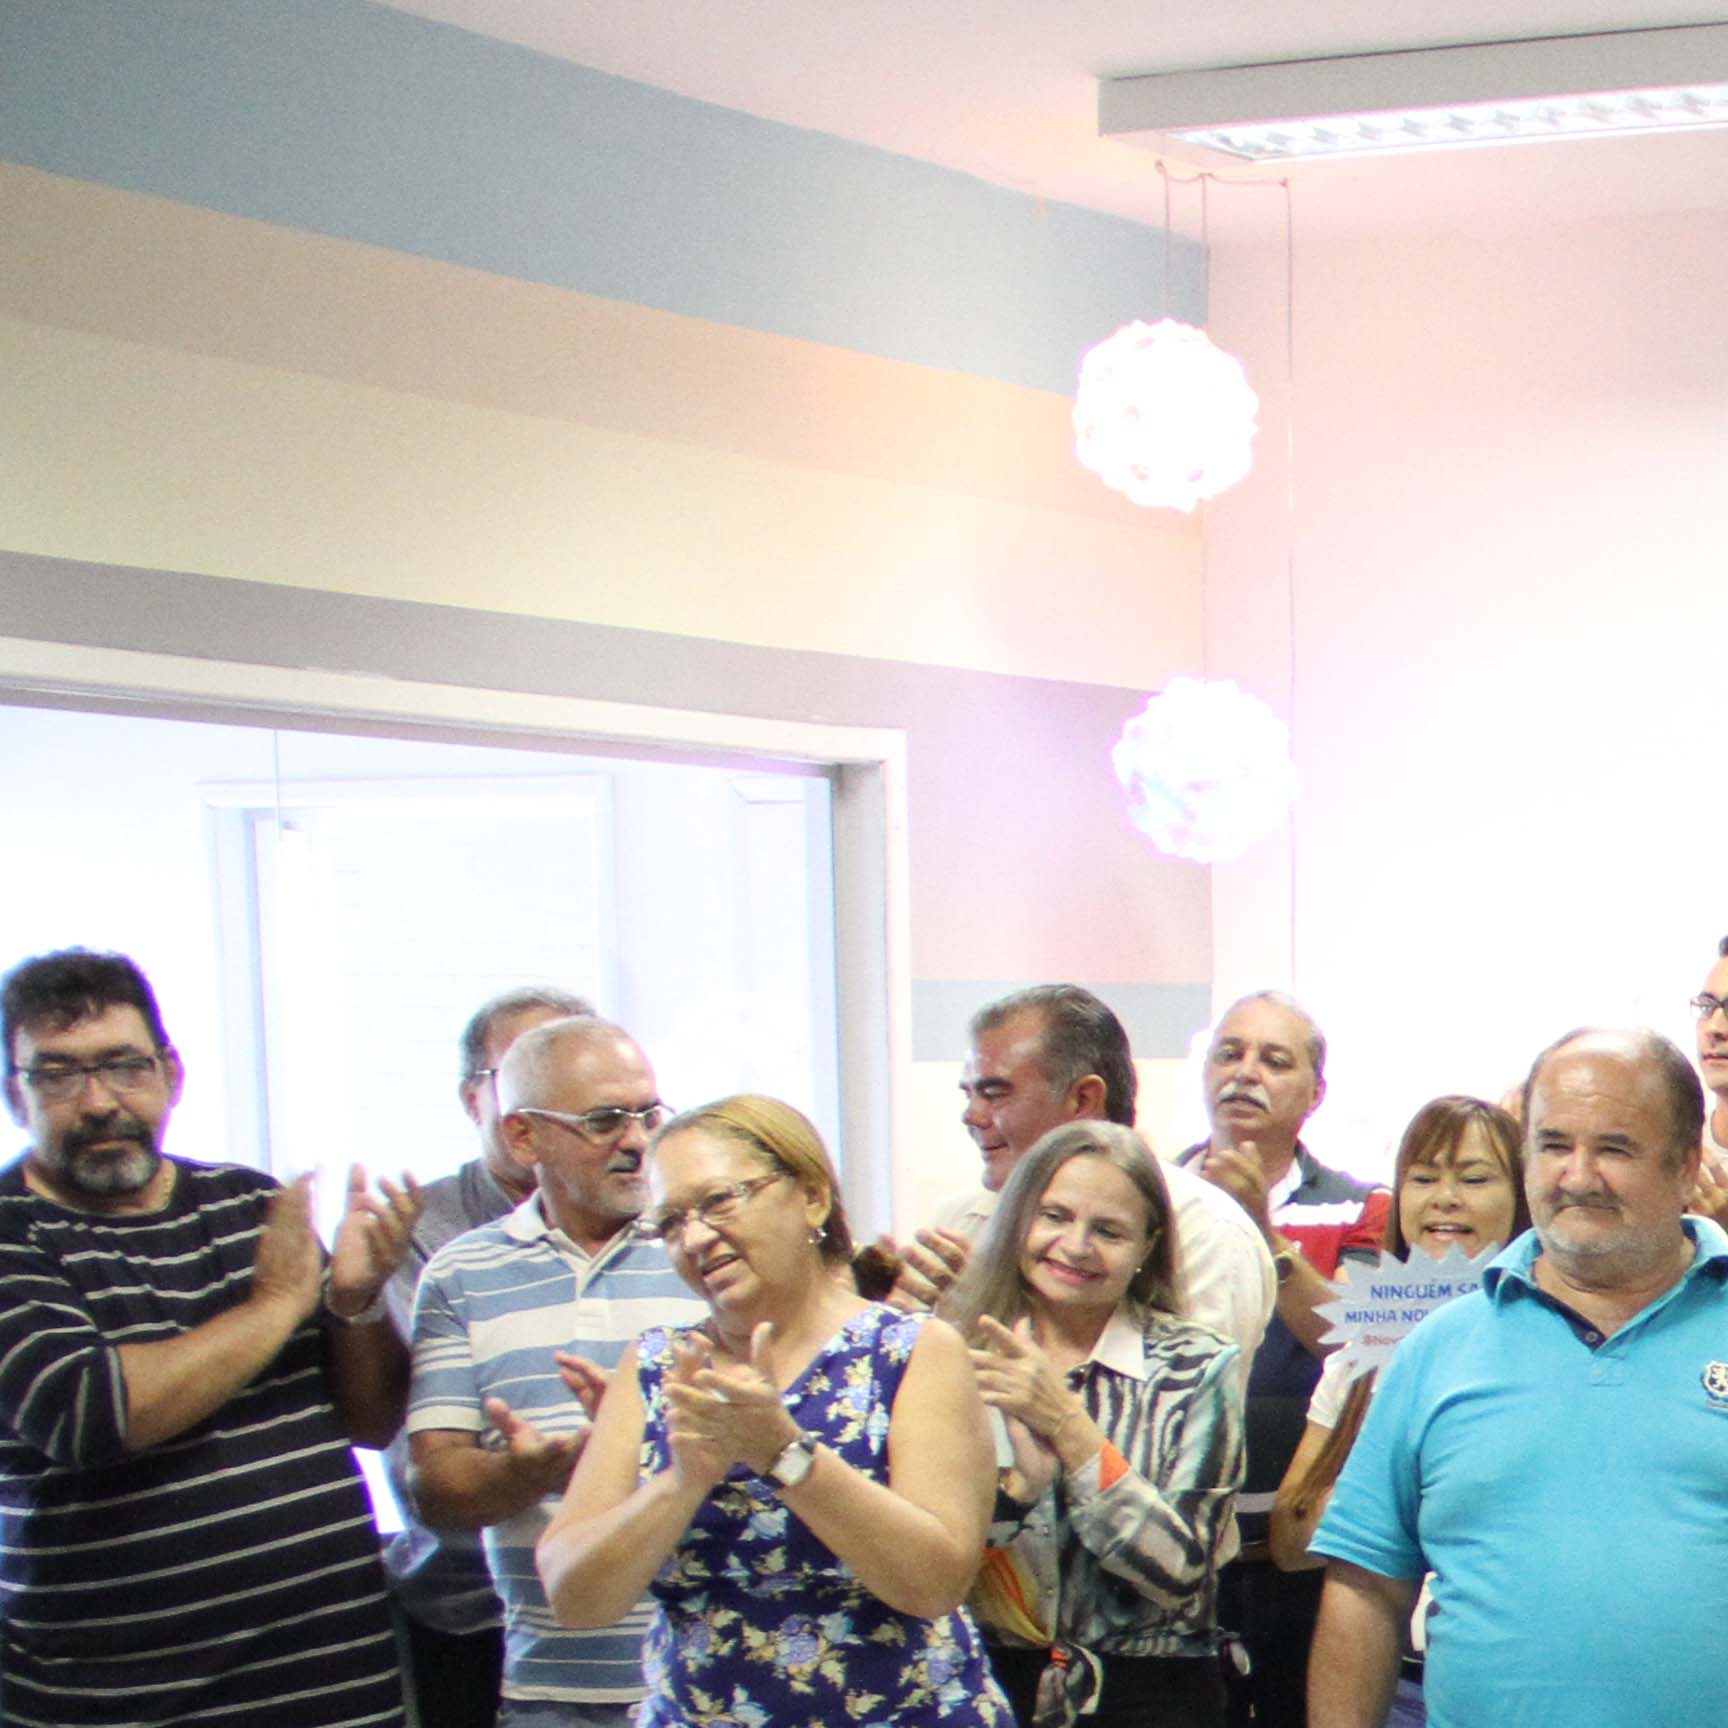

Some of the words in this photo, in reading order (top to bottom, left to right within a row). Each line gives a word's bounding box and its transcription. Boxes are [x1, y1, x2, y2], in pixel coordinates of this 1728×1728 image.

[1370, 1278, 1453, 1300] NINGUÉM
[1457, 1282, 1479, 1295] SA
[1344, 1309, 1397, 1323] MINHA
